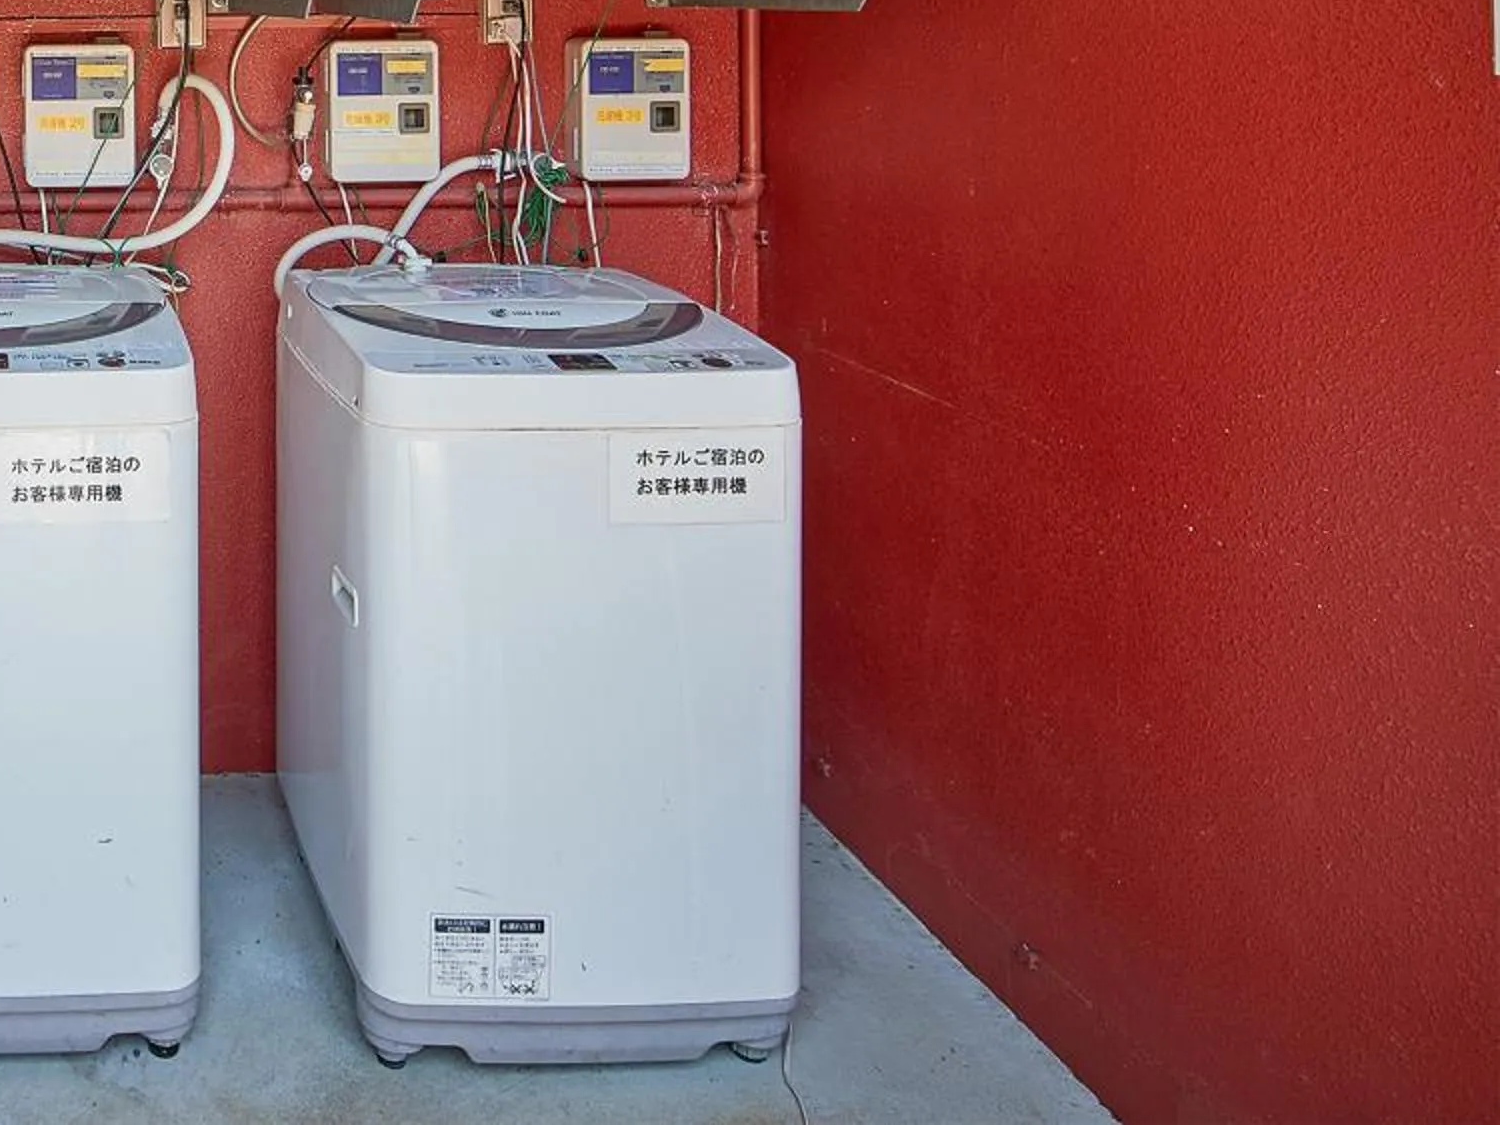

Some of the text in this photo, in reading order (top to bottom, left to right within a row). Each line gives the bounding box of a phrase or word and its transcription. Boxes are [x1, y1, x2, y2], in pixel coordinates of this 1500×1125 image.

[11, 457, 141, 475] ホテルご宿泊の
[636, 449, 765, 467] ホテルご宿泊の
[11, 485, 123, 503] お客様専用機
[636, 478, 748, 496] お客様専用機
